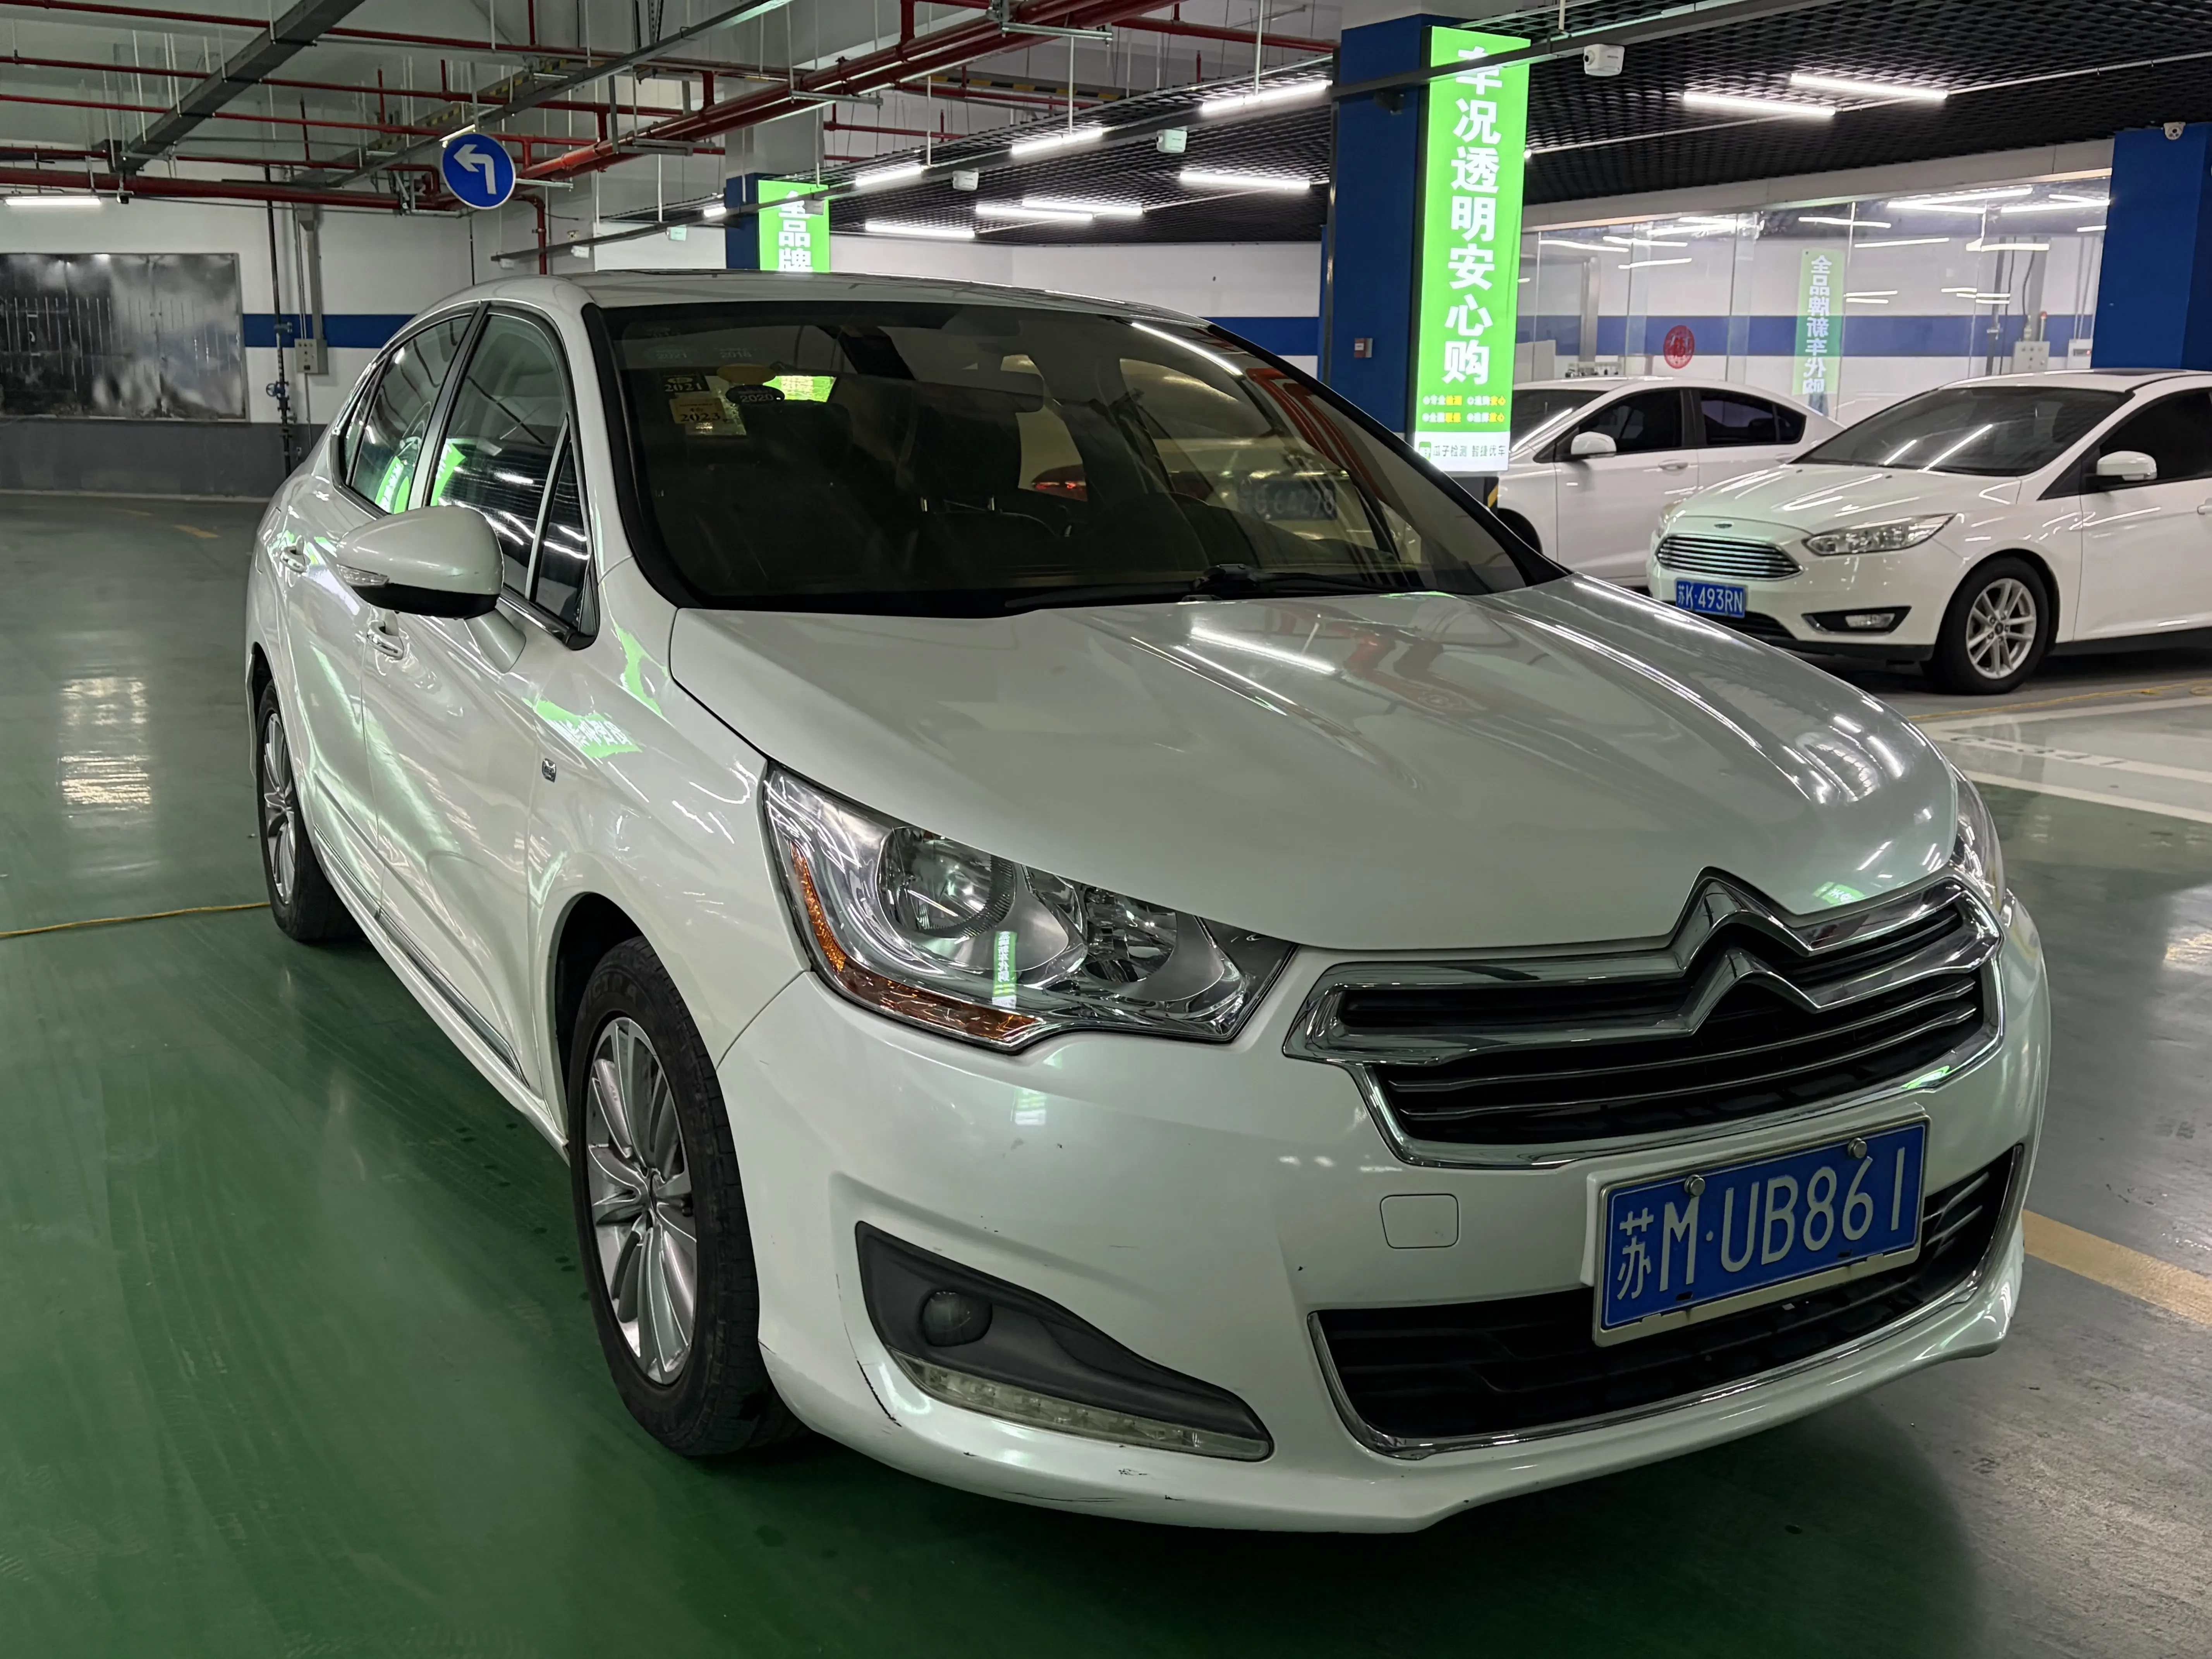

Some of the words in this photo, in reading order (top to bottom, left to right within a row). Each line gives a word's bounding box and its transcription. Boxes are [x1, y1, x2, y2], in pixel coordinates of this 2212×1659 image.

[1441, 46, 1503, 385] 车况透明安心购
[665, 383, 702, 392] 2021
[740, 394, 774, 402] 2020
[680, 412, 721, 422] 2023
[1678, 584, 1743, 613] 苏K·493RN
[1617, 1147, 1905, 1300] 苏M·UB861
